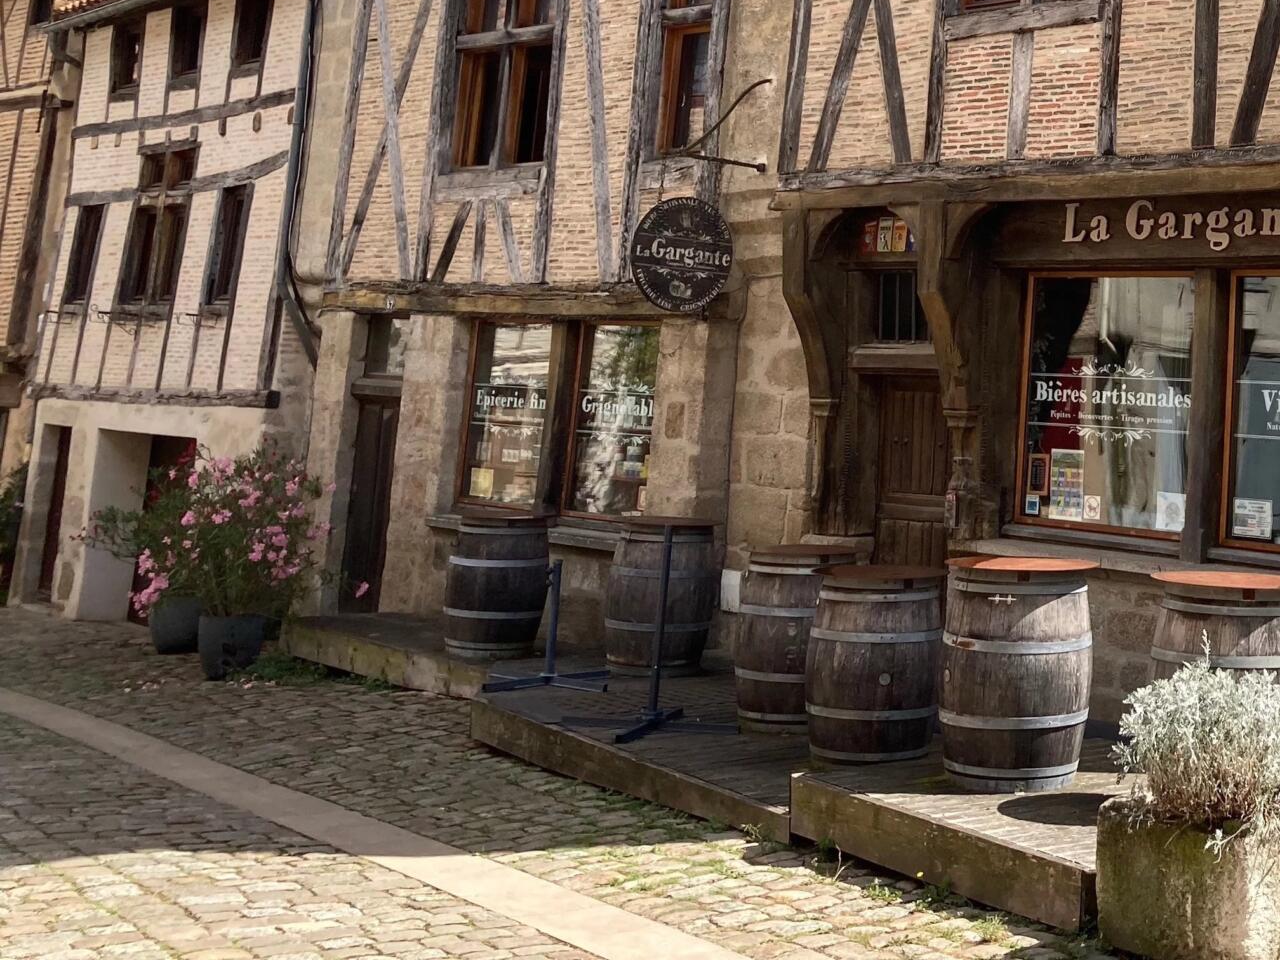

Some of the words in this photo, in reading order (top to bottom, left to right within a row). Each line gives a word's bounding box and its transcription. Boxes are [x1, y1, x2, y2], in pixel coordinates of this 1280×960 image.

[1062, 202, 1110, 243] La
[636, 244, 650, 257] La
[651, 237, 731, 268] Gargante
[476, 389, 525, 410] Epicerie
[529, 391, 547, 410] fin
[581, 395, 654, 417] Grignotabl
[1034, 380, 1088, 403] Bières
[1091, 383, 1193, 409] artisanales
